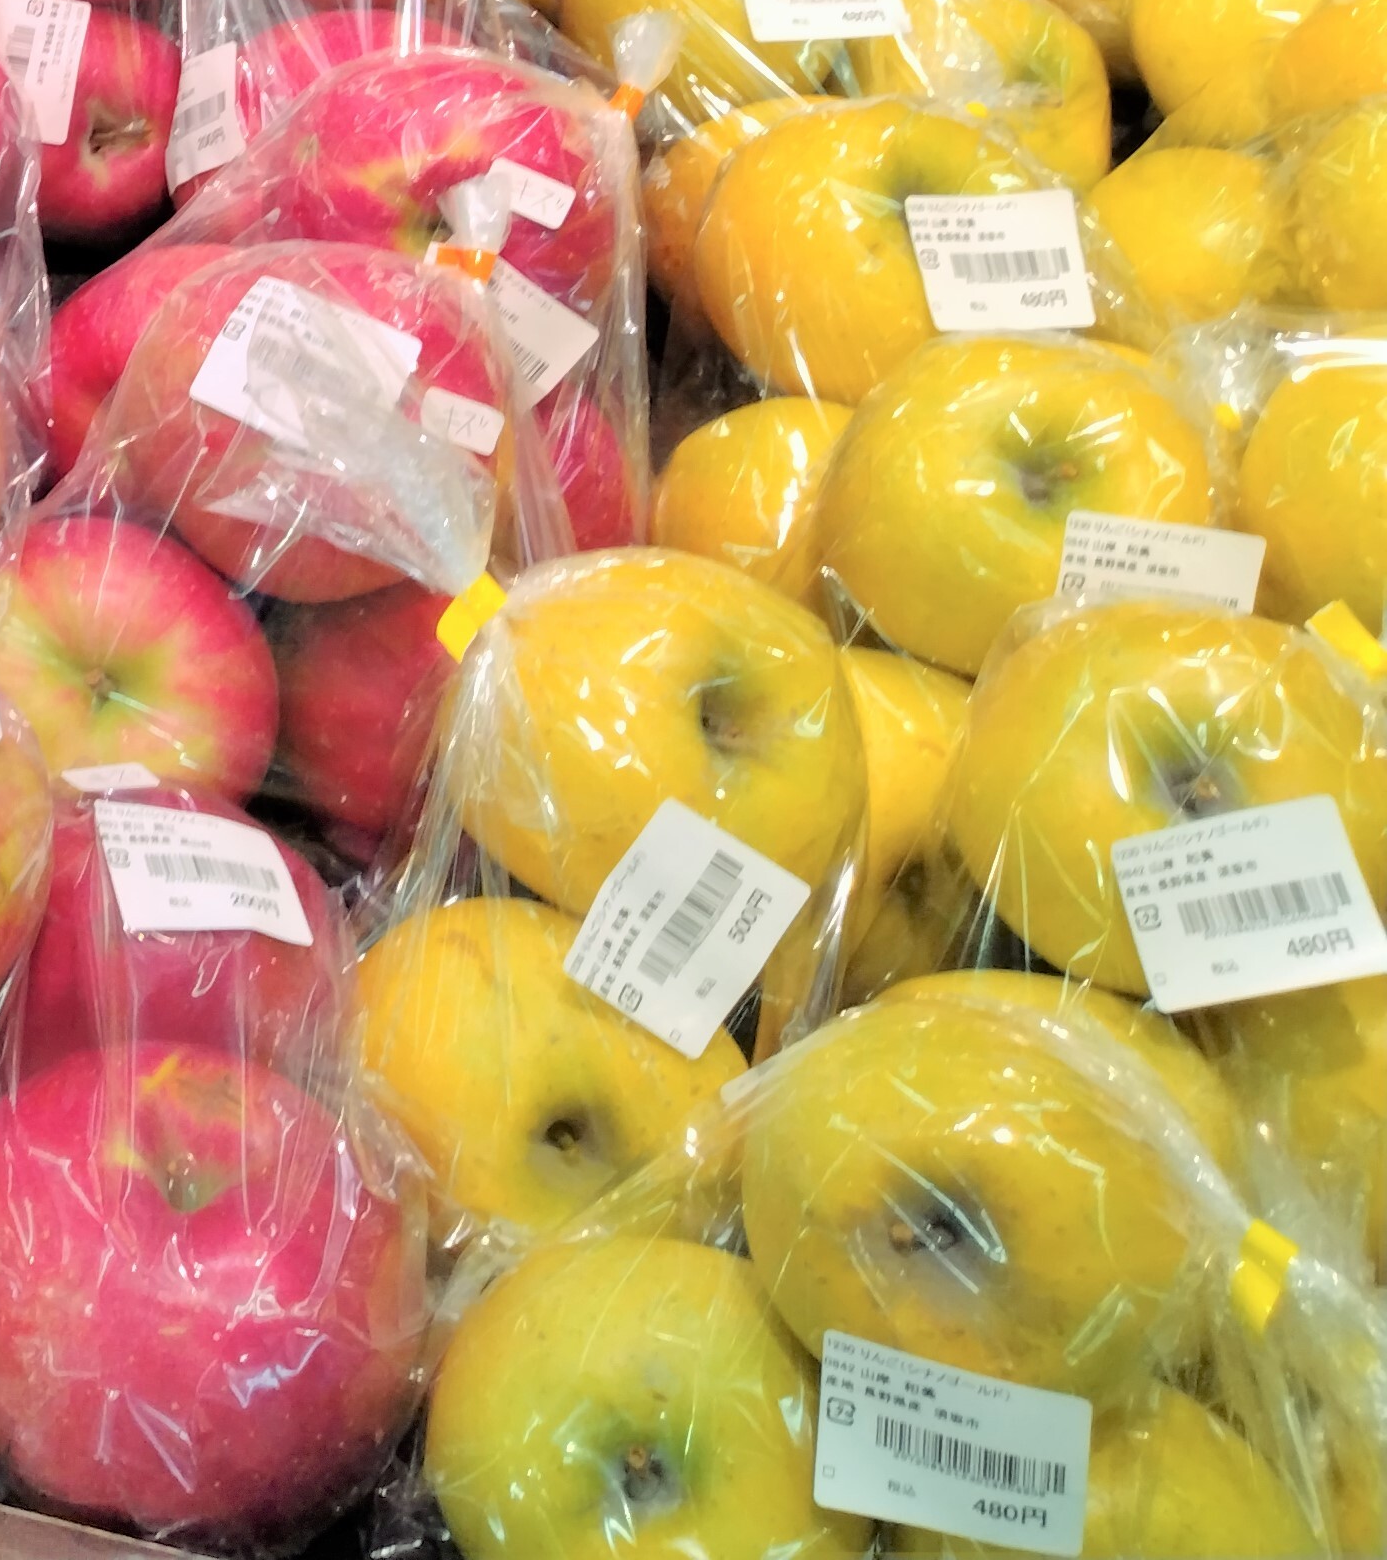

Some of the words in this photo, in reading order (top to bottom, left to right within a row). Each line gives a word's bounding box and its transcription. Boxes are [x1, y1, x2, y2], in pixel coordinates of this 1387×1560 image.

[727, 886, 773, 946] 500円
[1285, 926, 1356, 958] 480円
[972, 1496, 1048, 1530] 480円
